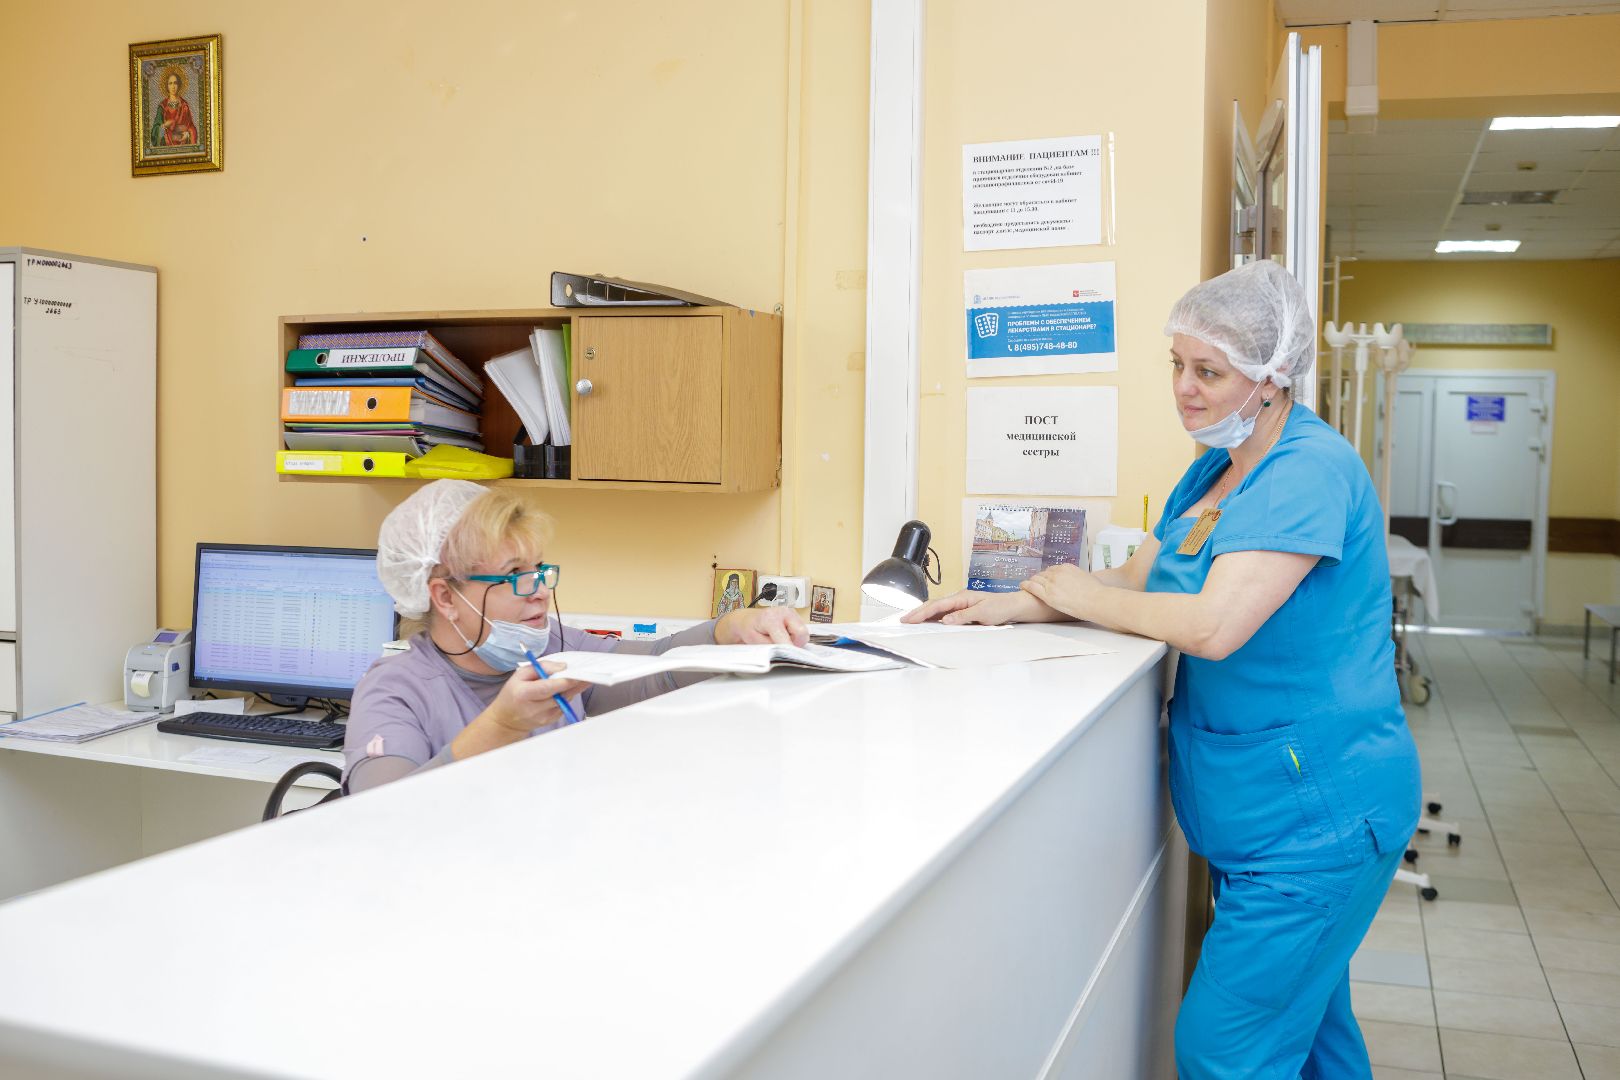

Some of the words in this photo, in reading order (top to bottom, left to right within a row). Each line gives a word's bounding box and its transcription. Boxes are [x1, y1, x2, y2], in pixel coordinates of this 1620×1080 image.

[973, 153, 1025, 163] ВНИМАНИЕ
[1029, 149, 1088, 160] ПАЦИЕНТАМ
[1007, 319, 1040, 327] ПРОБЛЕМЫ
[1046, 317, 1091, 325] ОБЕСПЕЧЕНИЕМ
[1007, 326, 1050, 334] ЛЕКАРСТВАМИ
[1056, 323, 1097, 331] СТАЦИОНАРЕ?
[341, 353, 406, 363] ПРОЛЕЖНИ
[1025, 415, 1059, 424] ПОСТ
[1006, 431, 1077, 441] медицинской
[1022, 449, 1060, 458] сестры
